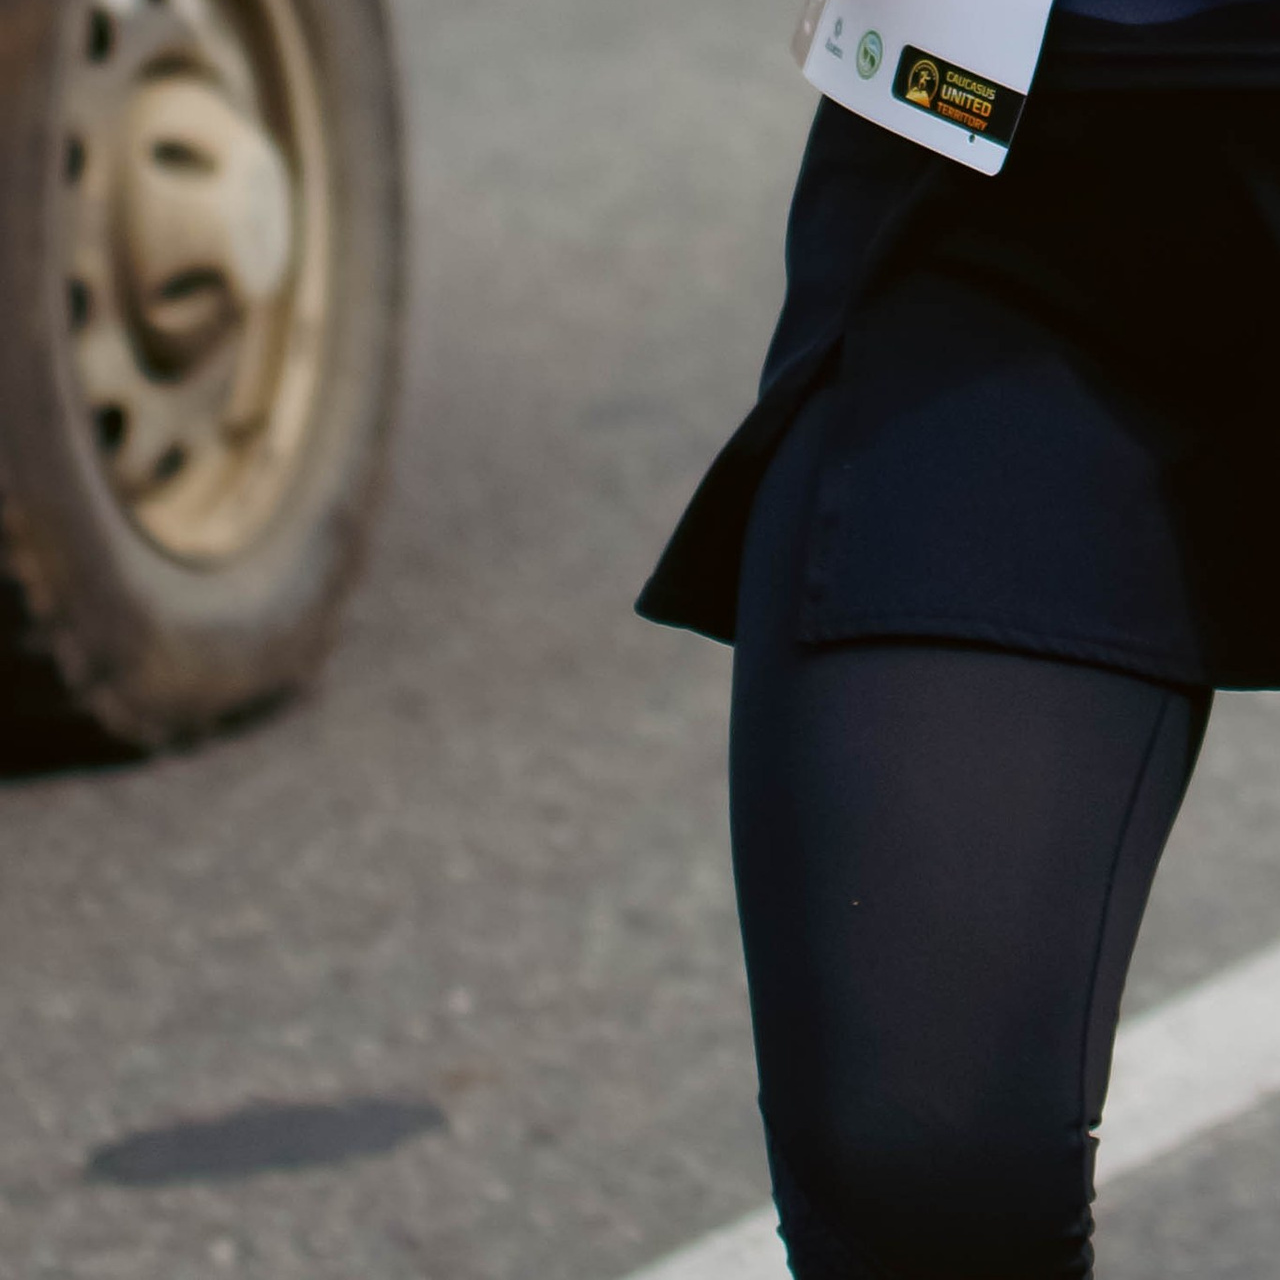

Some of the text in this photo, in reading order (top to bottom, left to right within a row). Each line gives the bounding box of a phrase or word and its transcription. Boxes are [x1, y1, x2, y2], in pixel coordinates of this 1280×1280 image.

[946, 70, 997, 100] CAUCASUS
[937, 101, 988, 131] TERRITORY
[941, 84, 992, 118] UNITED
